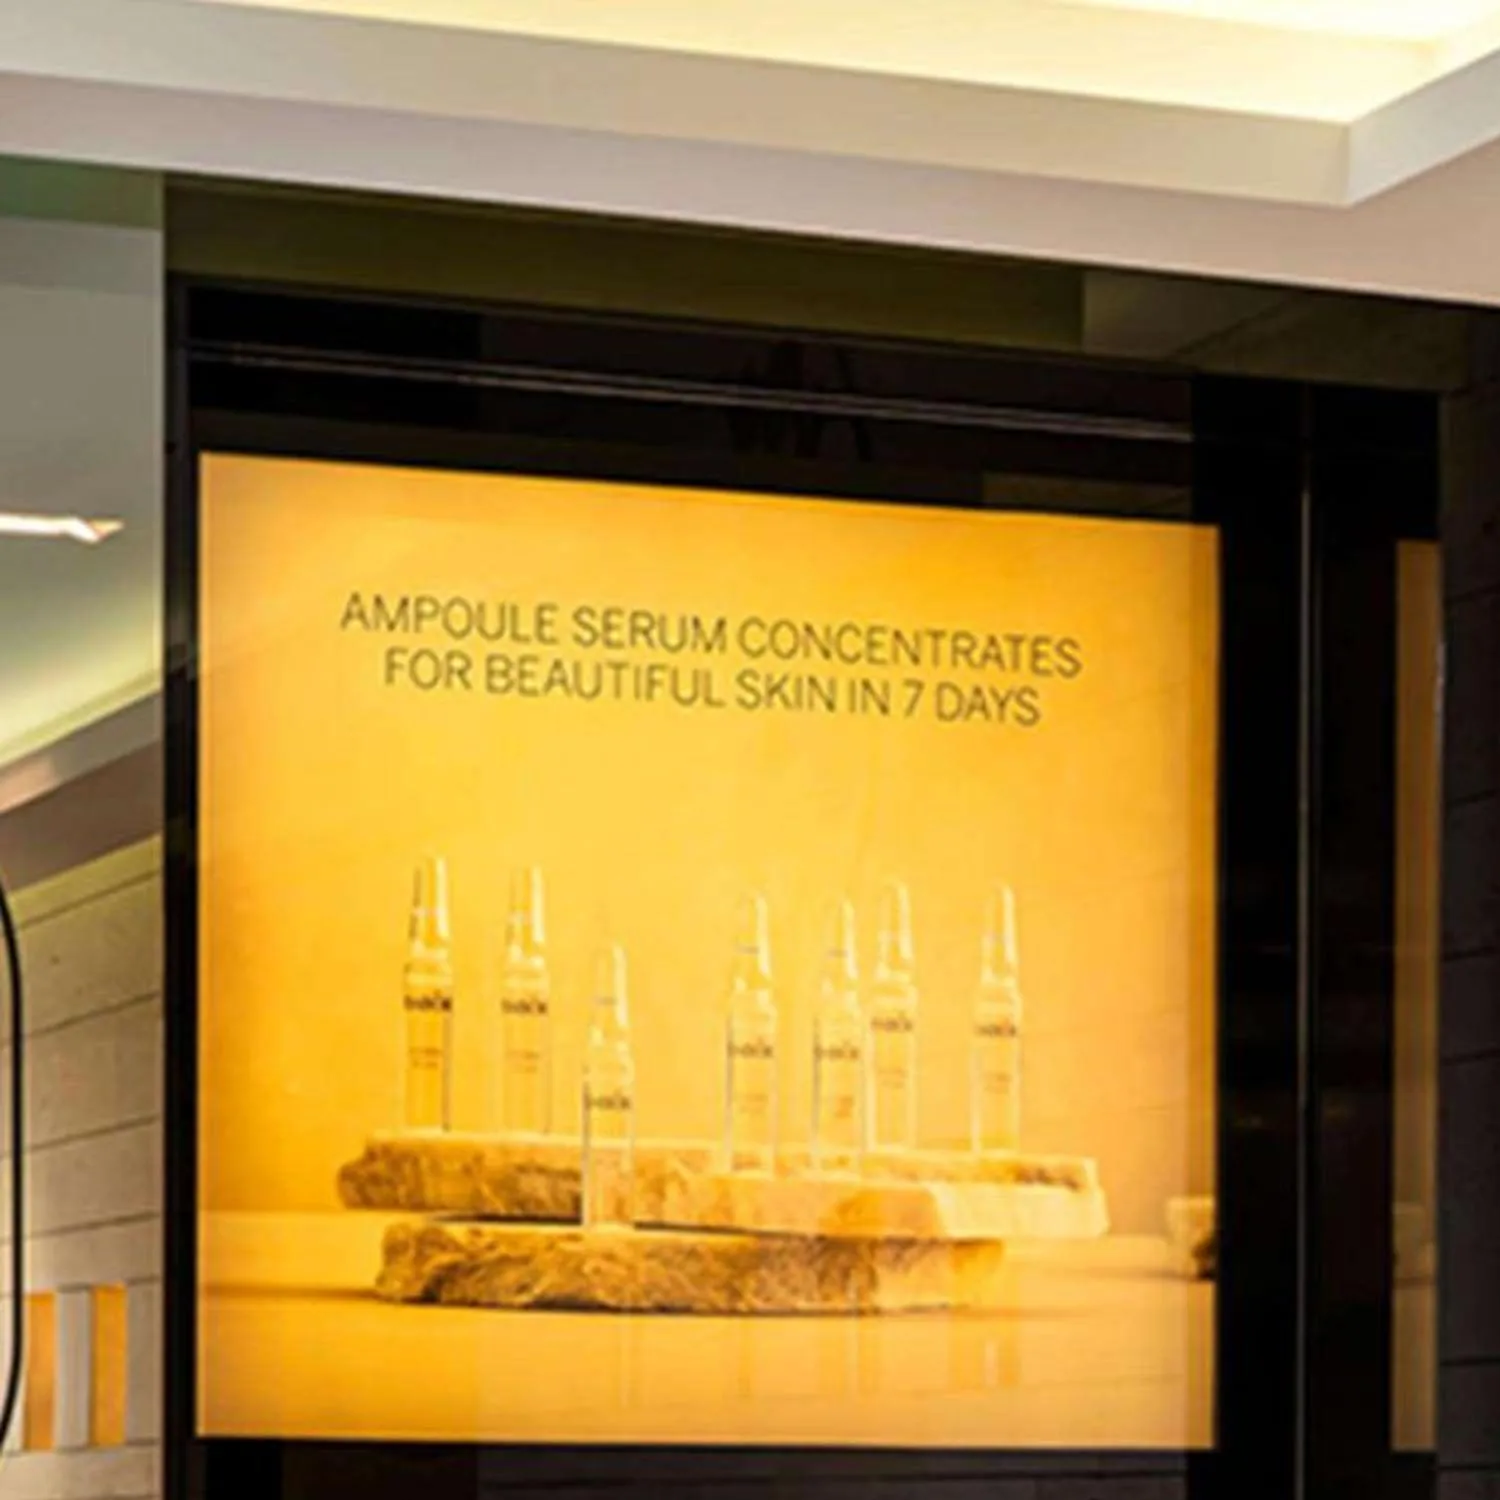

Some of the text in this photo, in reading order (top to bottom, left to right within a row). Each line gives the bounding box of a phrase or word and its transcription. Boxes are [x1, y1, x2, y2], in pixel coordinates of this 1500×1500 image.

[340, 590, 1083, 680] AMPOULE SERUM CONCENTRATES
[383, 645, 1042, 728] FOR BEAUTIFUL SKIN IN 7 DAYS
